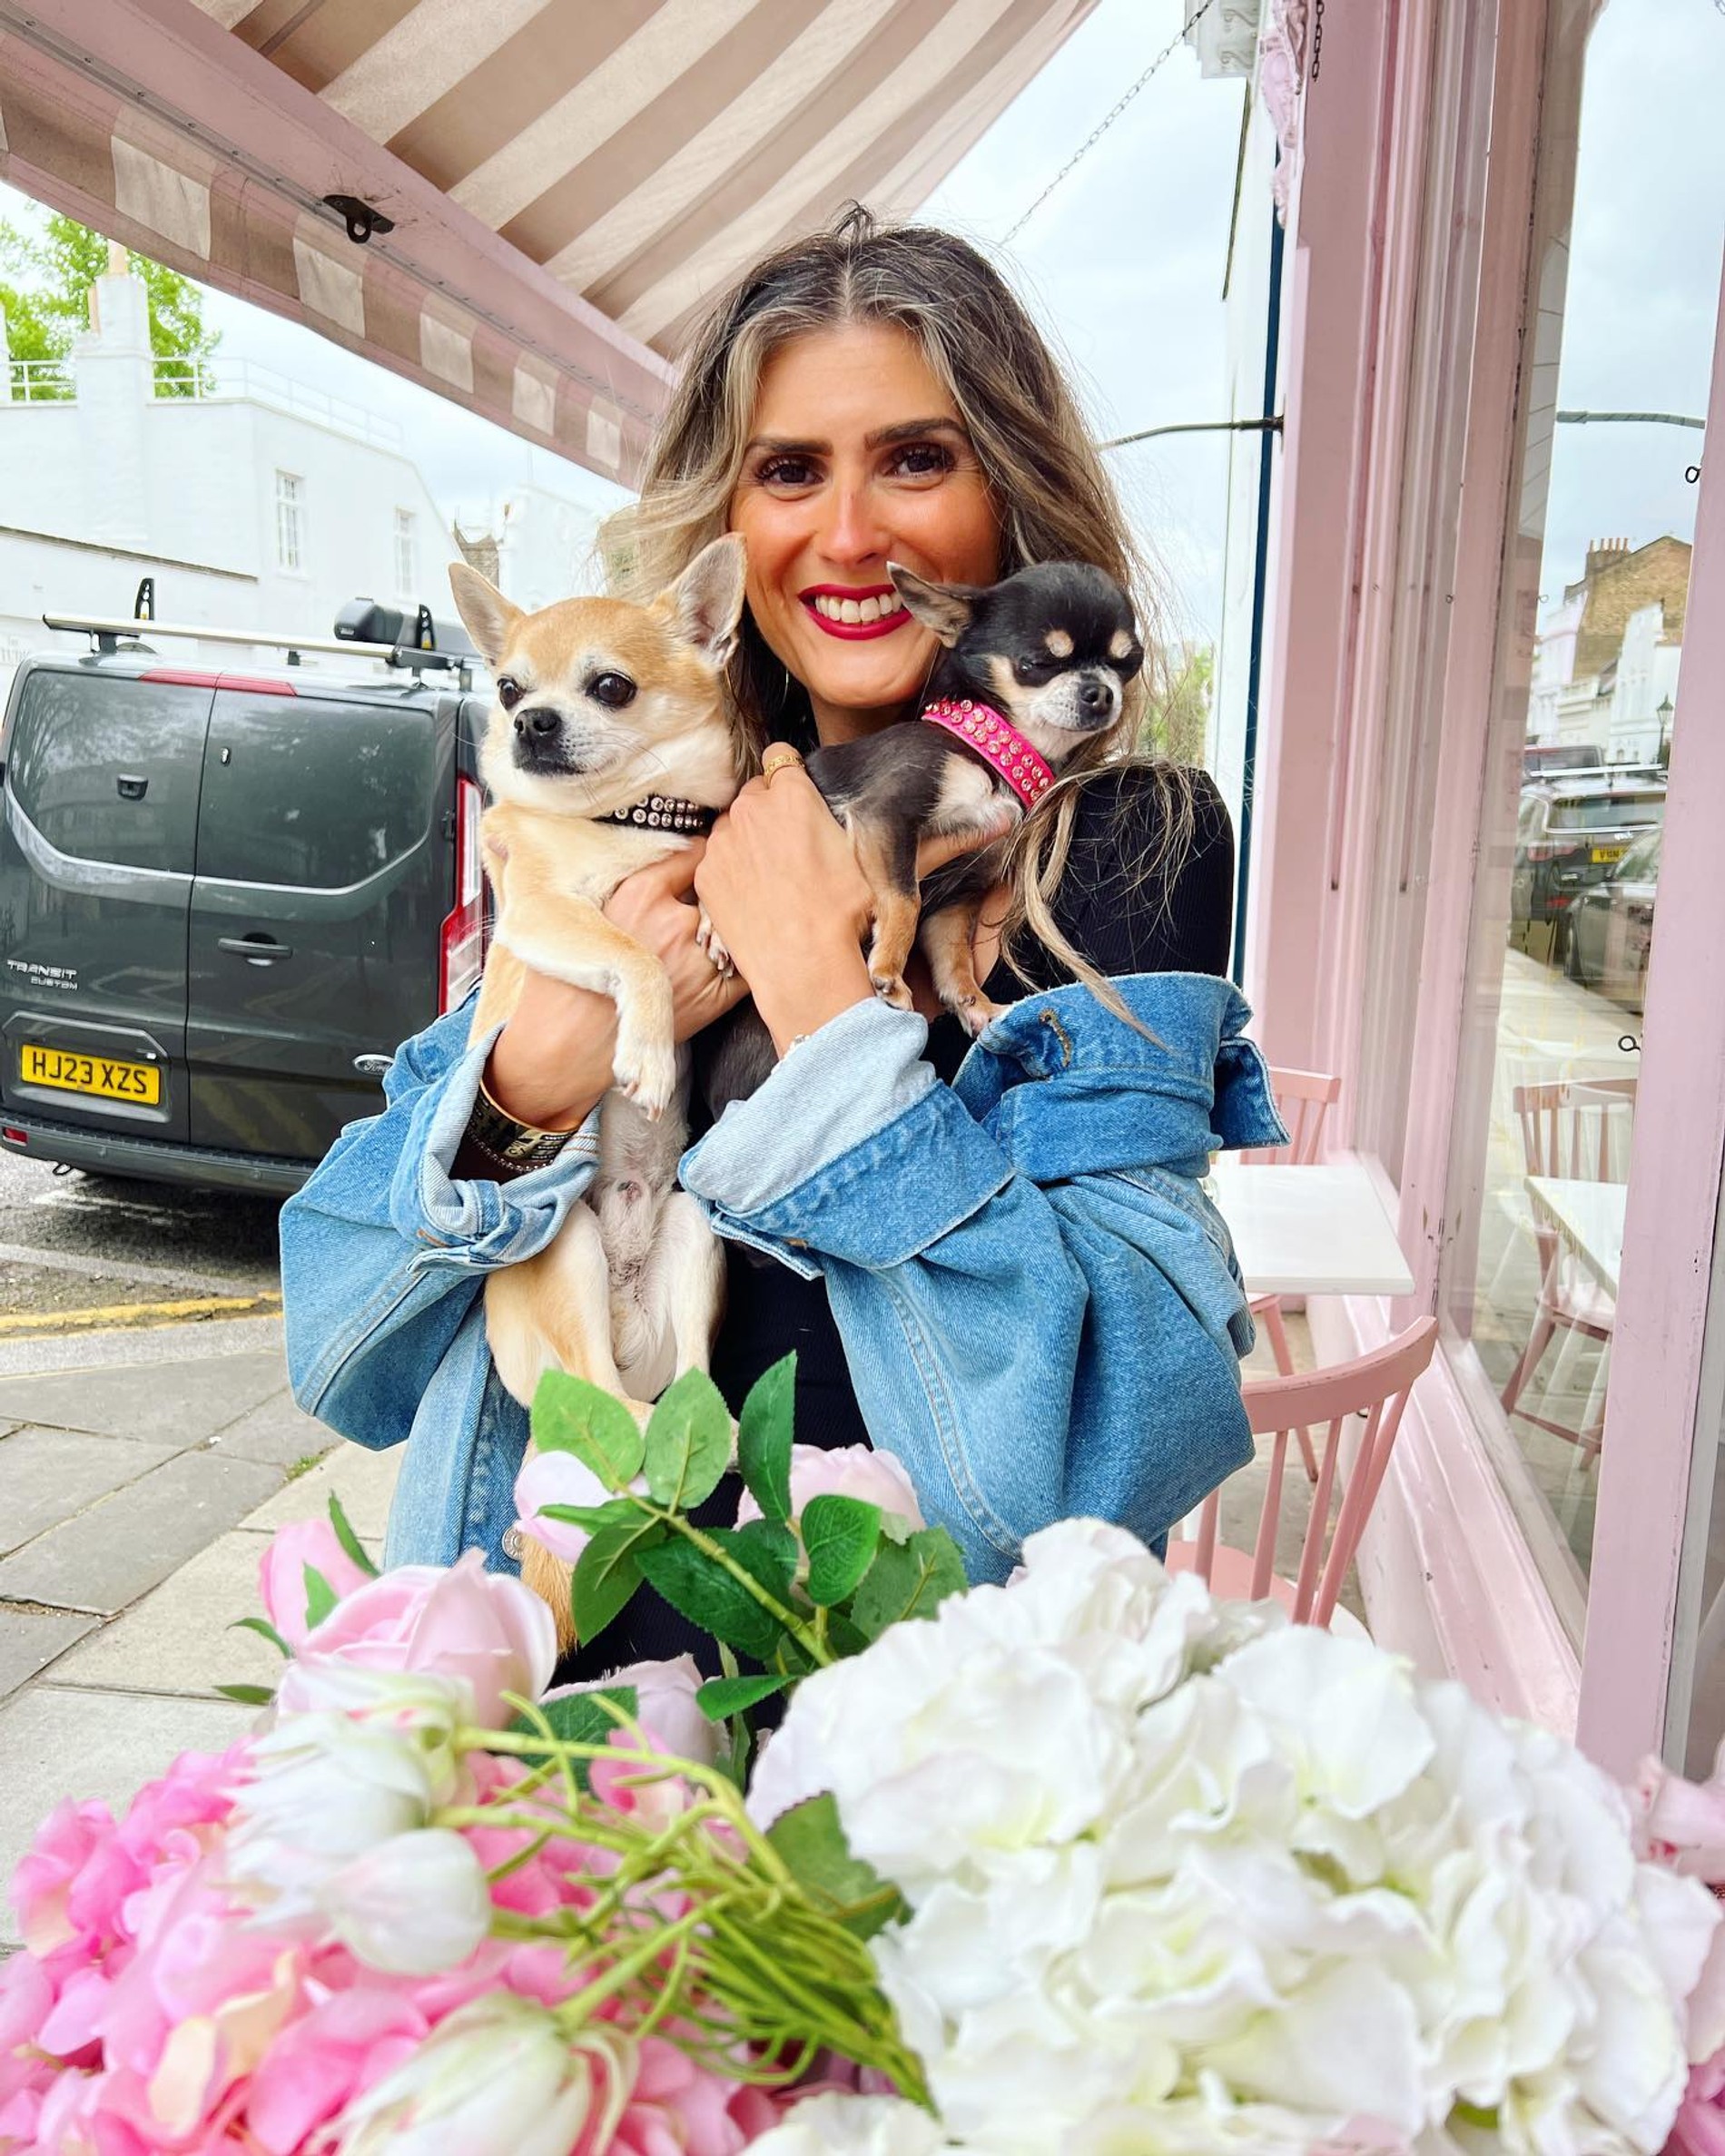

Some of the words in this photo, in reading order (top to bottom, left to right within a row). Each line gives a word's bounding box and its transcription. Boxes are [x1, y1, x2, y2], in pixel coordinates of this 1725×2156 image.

[7, 959, 77, 980] TRANSIT
[31, 976, 78, 990] CUSTOM
[33, 1051, 93, 1085] HJ23
[102, 1064, 147, 1094] XZS
